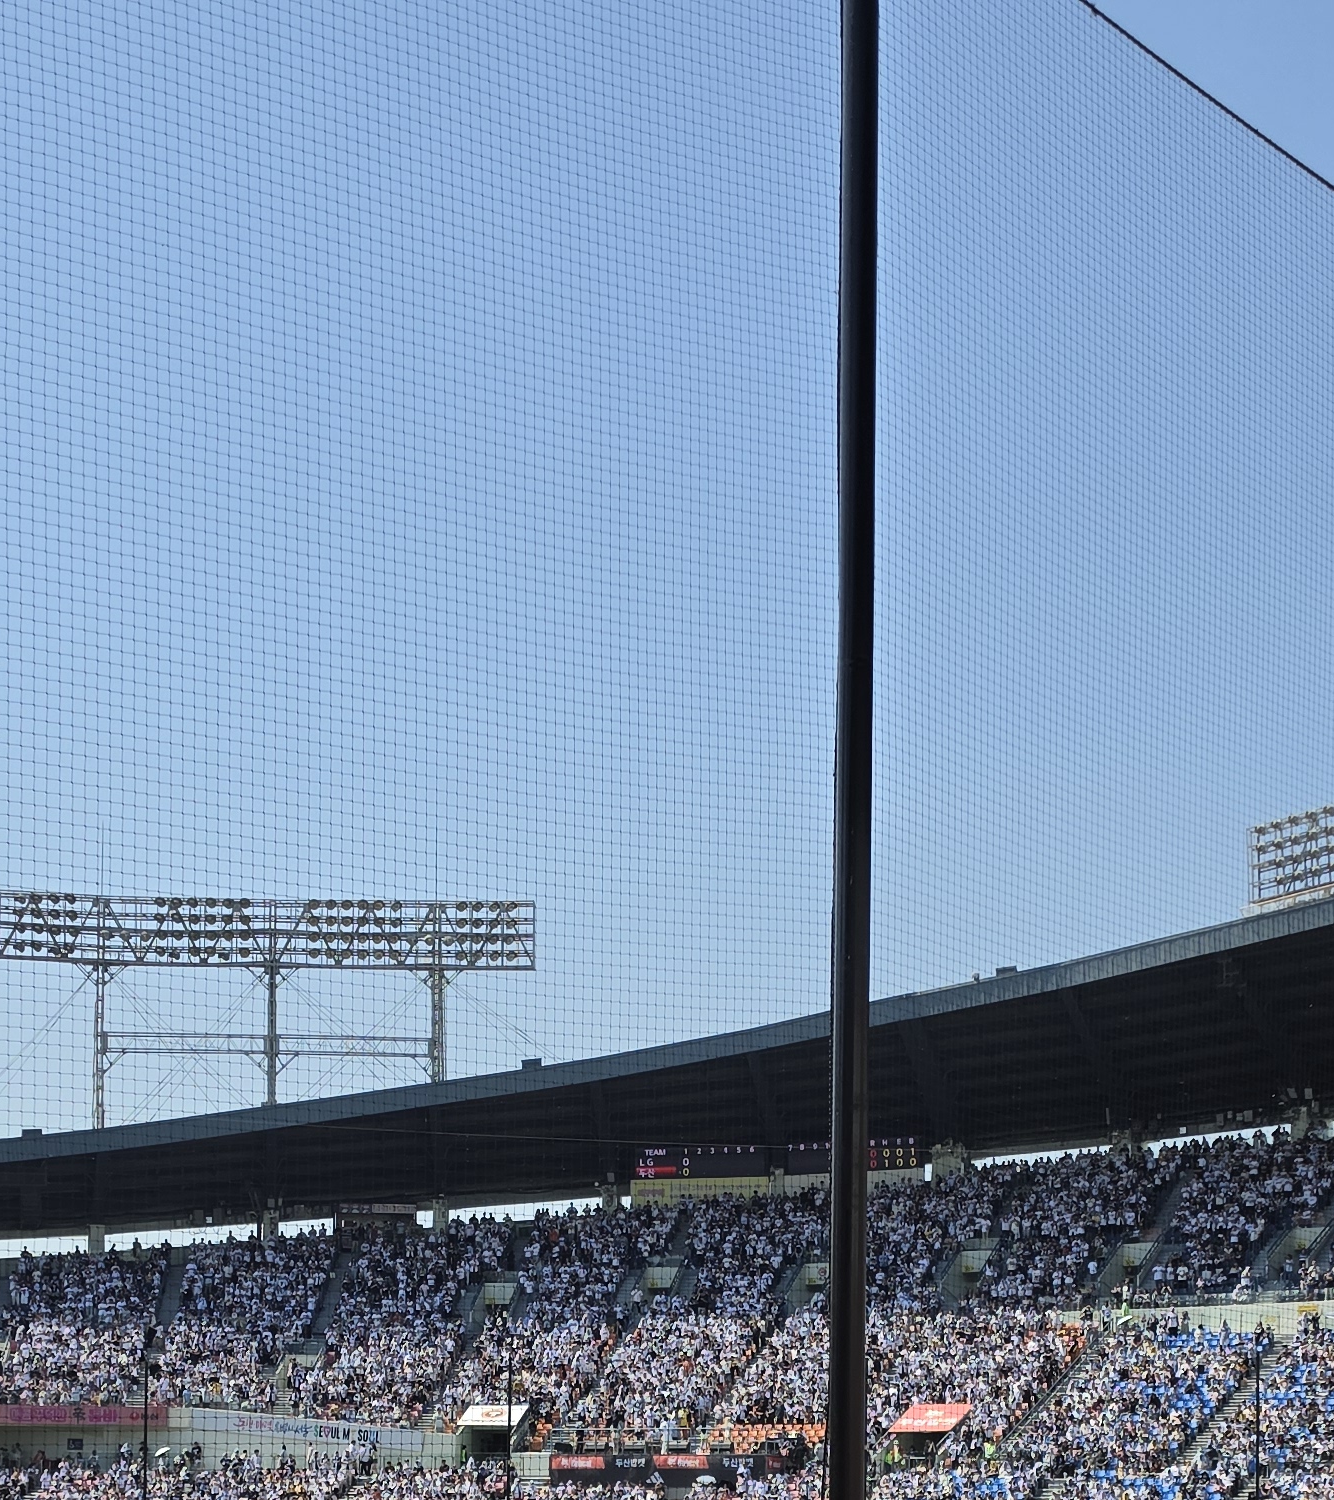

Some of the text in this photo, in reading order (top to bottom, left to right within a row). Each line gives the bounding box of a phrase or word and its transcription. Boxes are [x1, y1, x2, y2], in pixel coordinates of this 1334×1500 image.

[644, 1148, 666, 1156] TEAM
[684, 1147, 688, 1155] 1
[682, 1157, 690, 1166] 0
[682, 1167, 690, 1176] 0
[357, 1431, 381, 1444] SOUL
